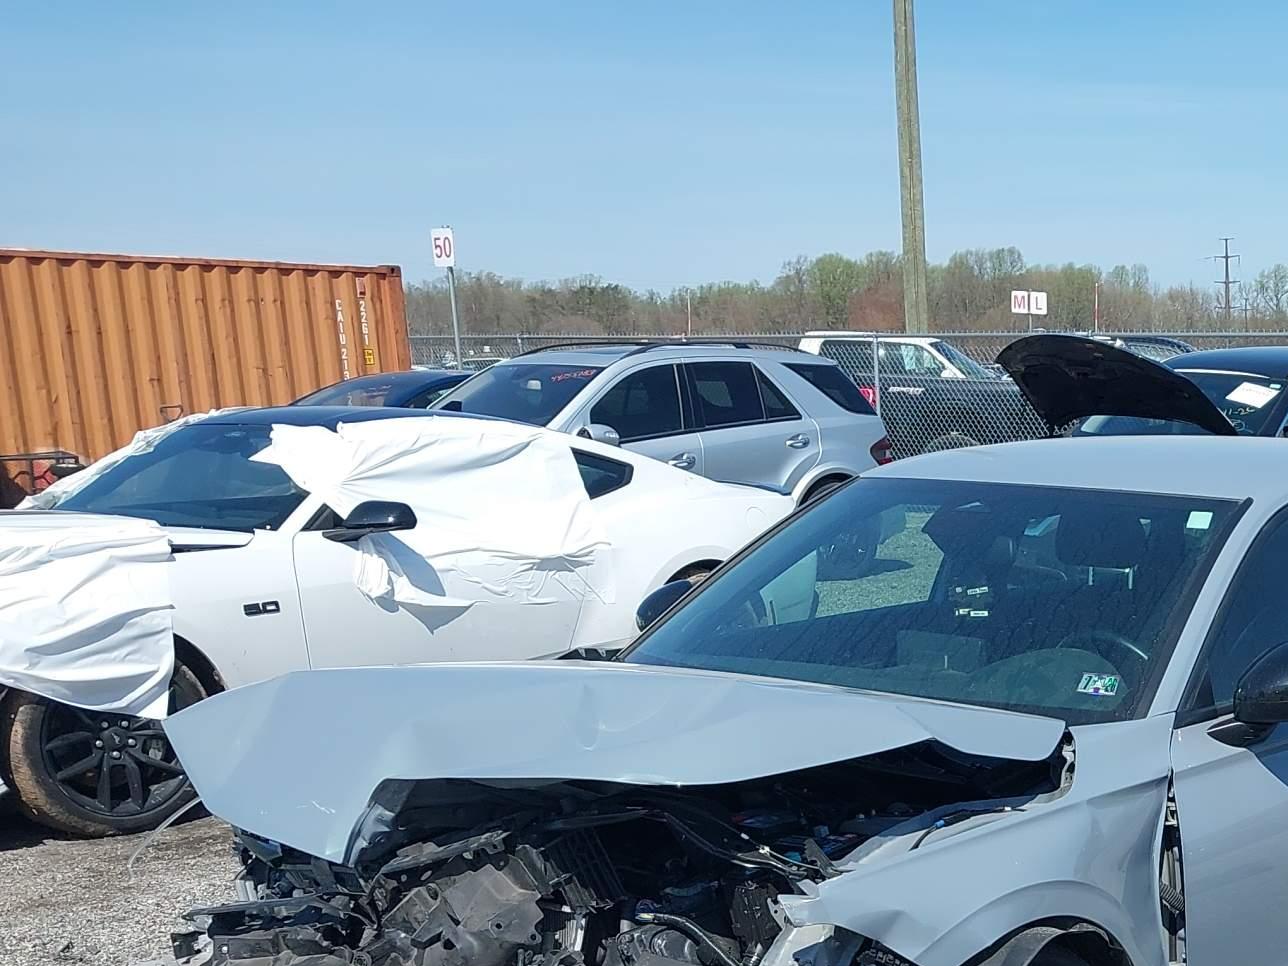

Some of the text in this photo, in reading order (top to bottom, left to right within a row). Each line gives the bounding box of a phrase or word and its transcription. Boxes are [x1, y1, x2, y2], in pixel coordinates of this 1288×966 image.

[433, 236, 452, 259] 50
[1013, 295, 1026, 310] M
[1035, 295, 1043, 310] L
[335, 300, 347, 345] CAIU
